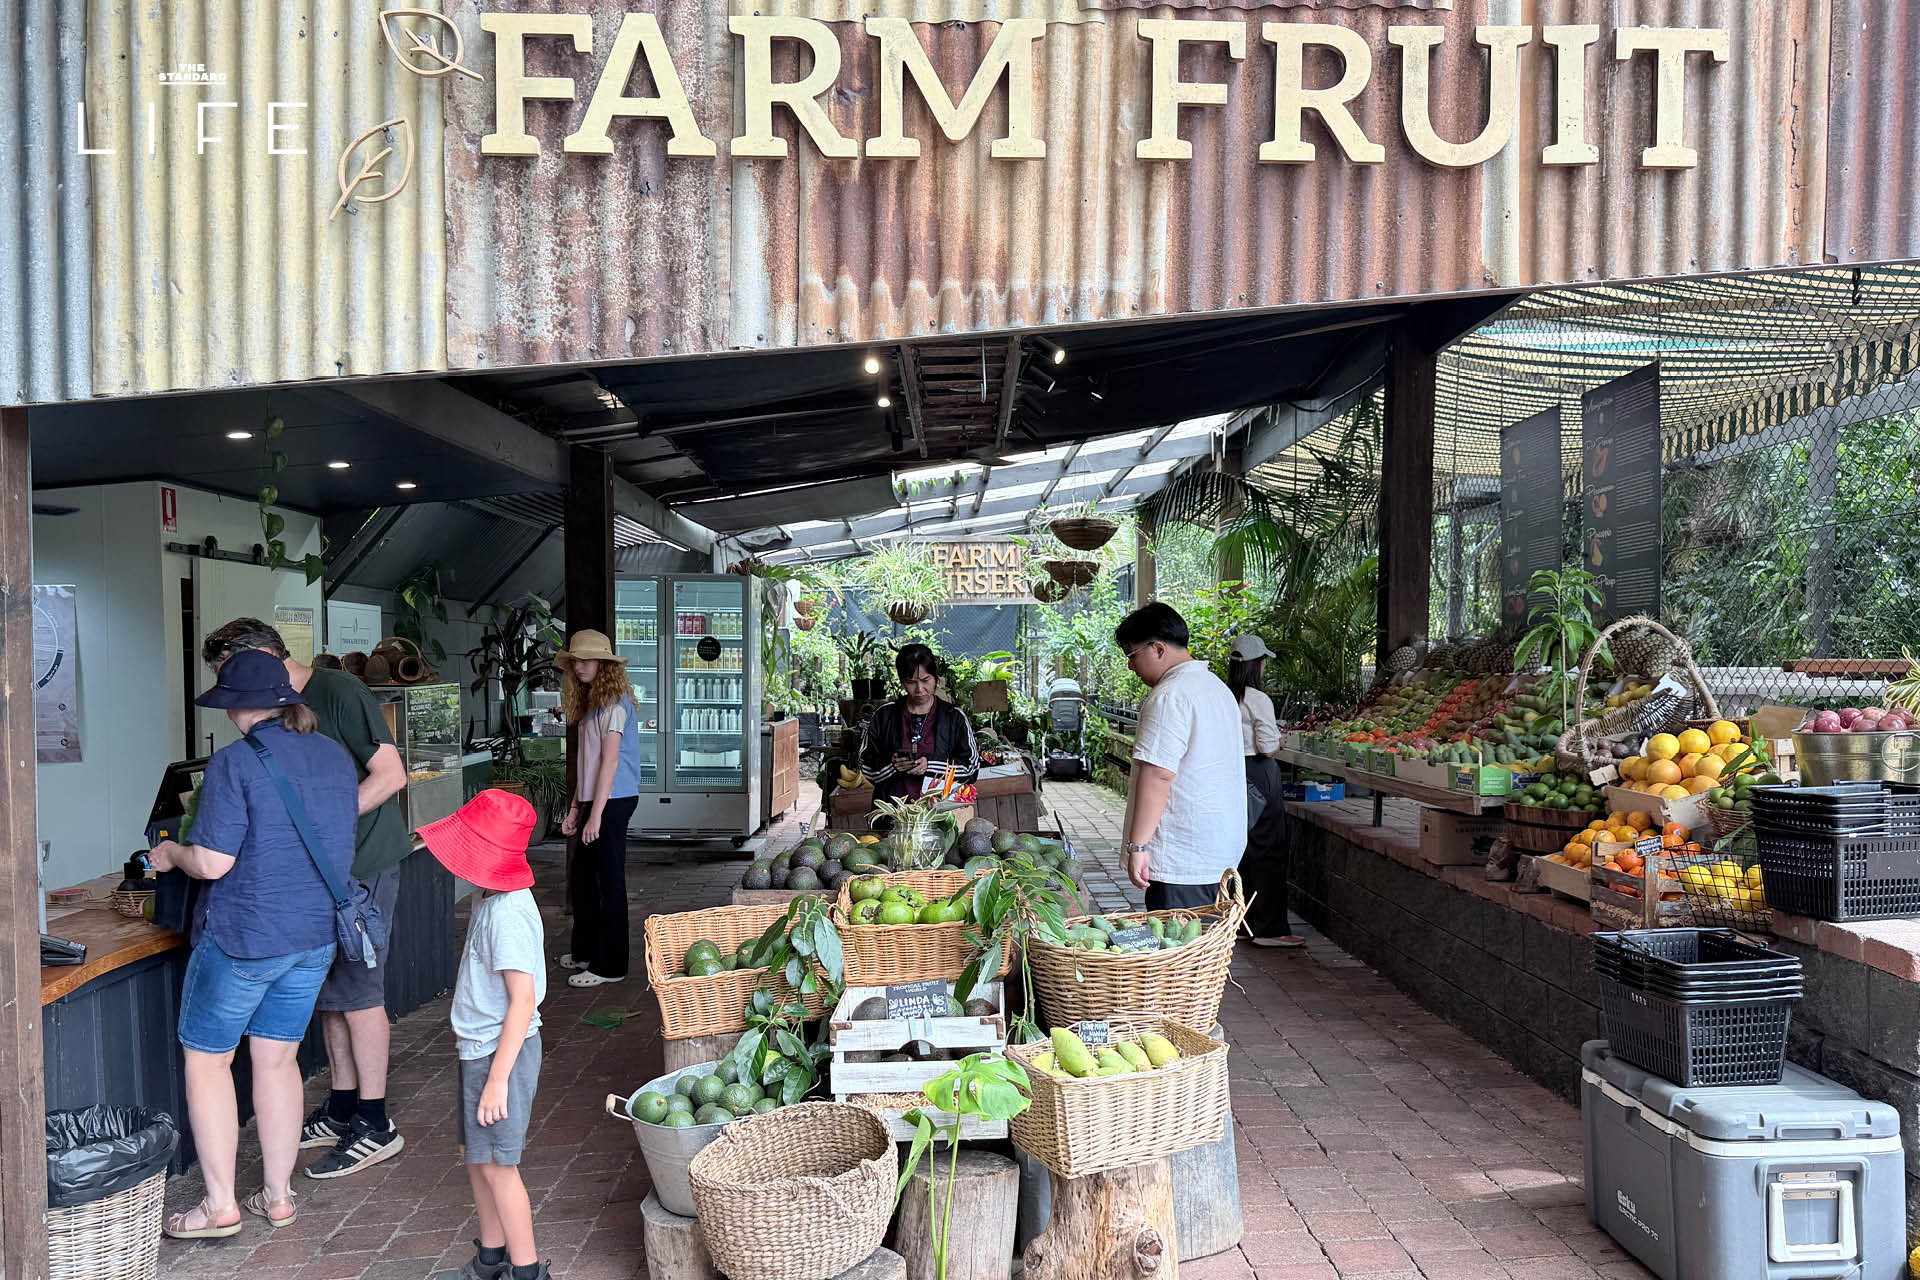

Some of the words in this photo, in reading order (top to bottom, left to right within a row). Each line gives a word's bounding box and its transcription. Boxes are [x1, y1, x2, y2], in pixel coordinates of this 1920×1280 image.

[480, 12, 1047, 160] FARM
[1135, 19, 1729, 168] FRUIT
[932, 545, 1016, 568] FARM
[893, 983, 921, 991] TROPICAL
[899, 995, 930, 1007] LINDA
